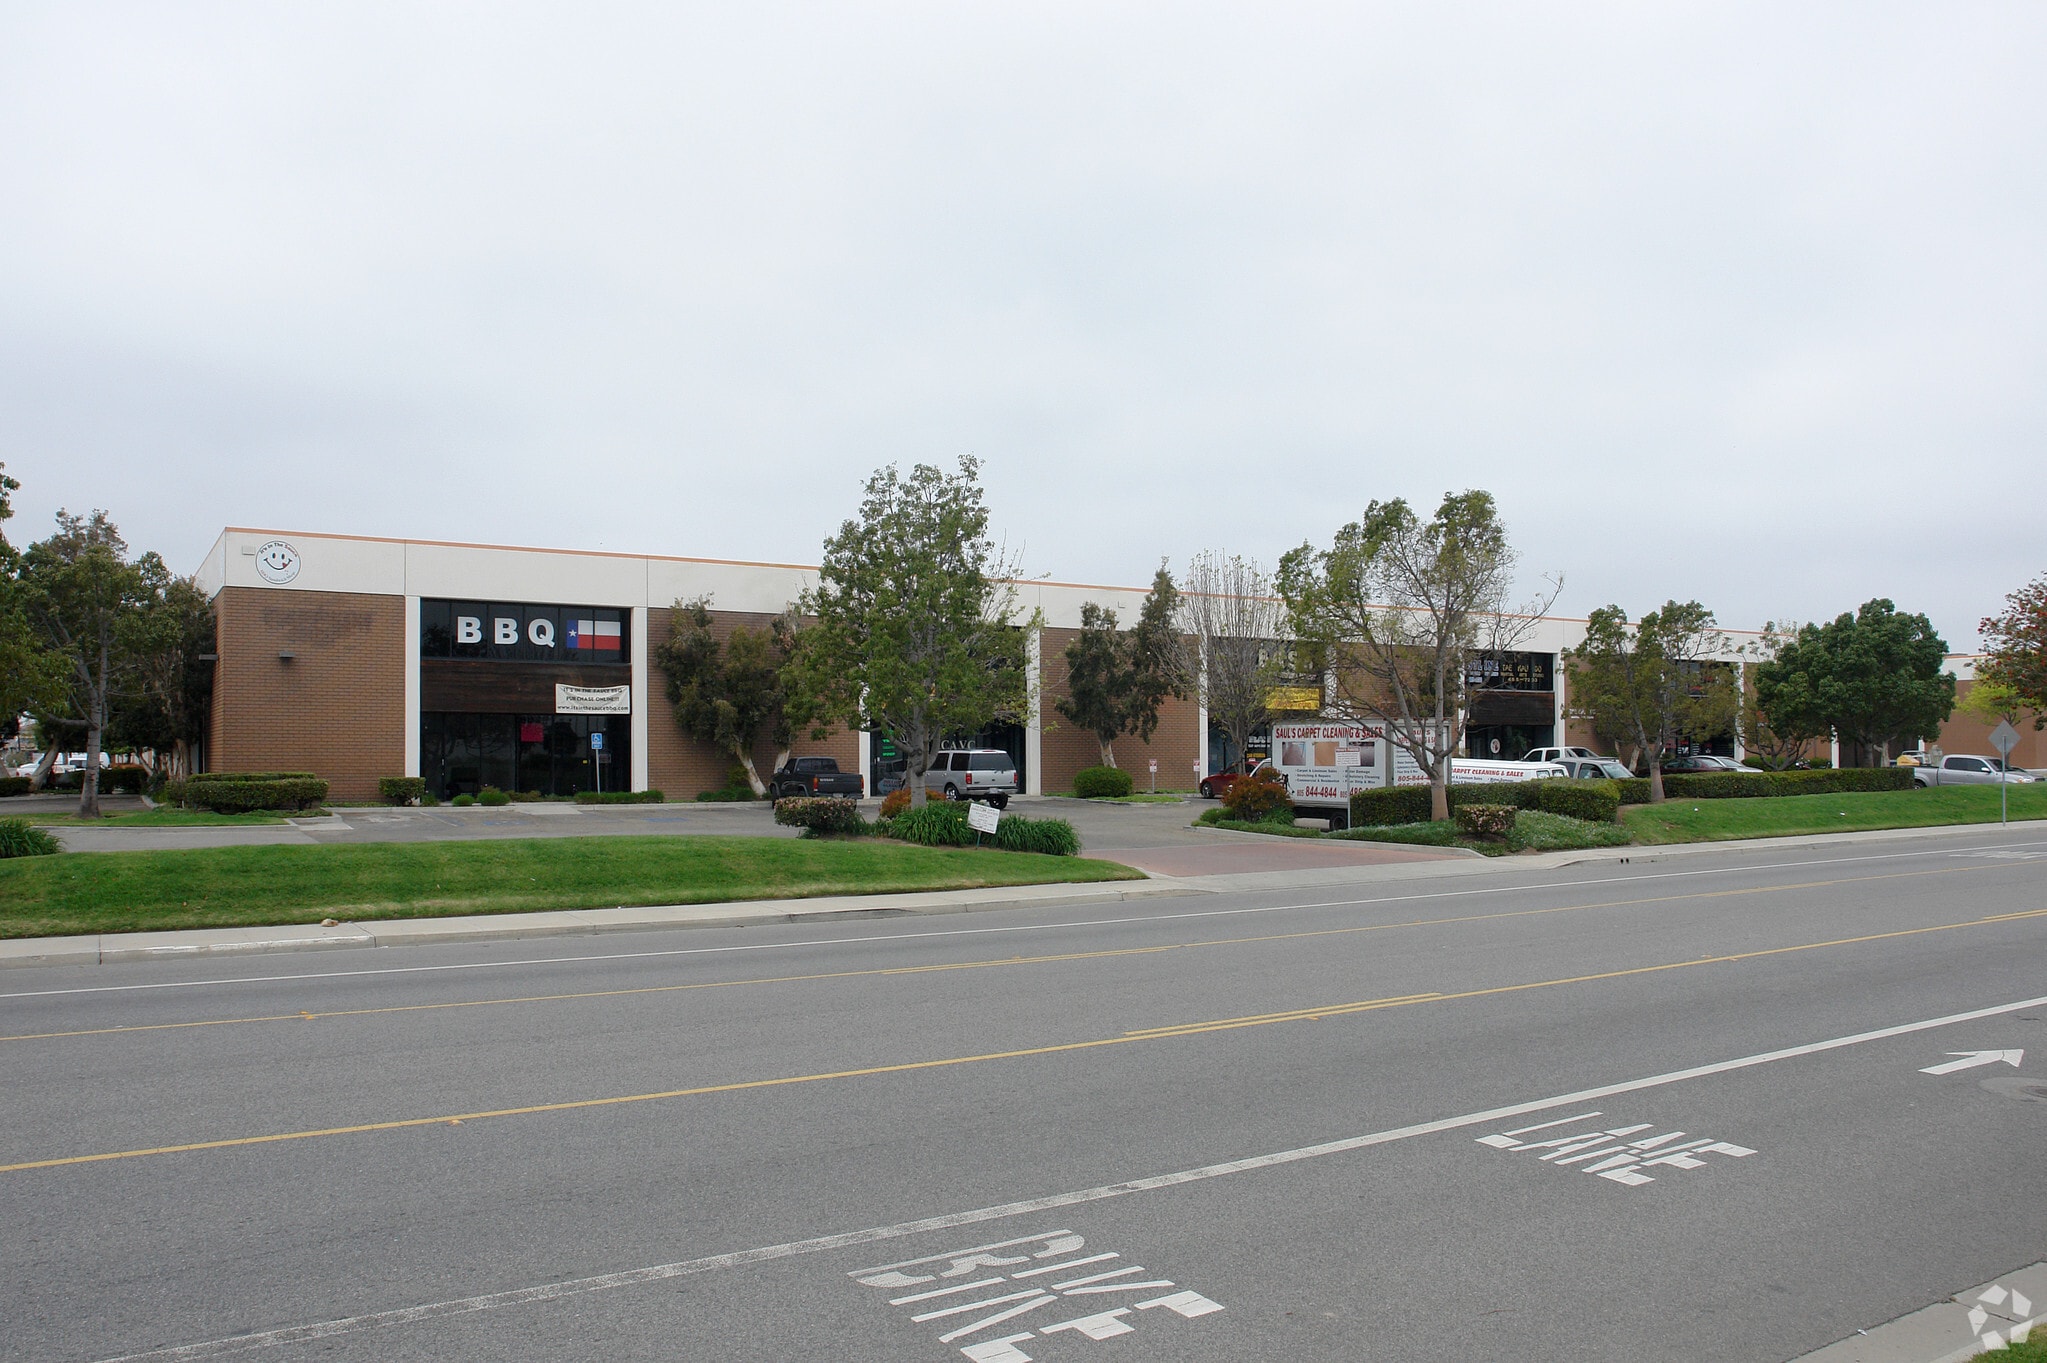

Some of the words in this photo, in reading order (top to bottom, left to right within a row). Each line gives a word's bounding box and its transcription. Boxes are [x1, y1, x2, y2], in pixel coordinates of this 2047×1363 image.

[456, 616, 556, 648] BBQ
[1276, 728, 1296, 738] SAUL'S
[1297, 727, 1321, 738] CARPET
[1323, 727, 1354, 738] CLEANING
[1355, 728, 1360, 738] &
[1305, 786, 1337, 798] 844-4844
[1474, 1111, 1759, 1186] LANE
[846, 1229, 1226, 1363] BIKE
